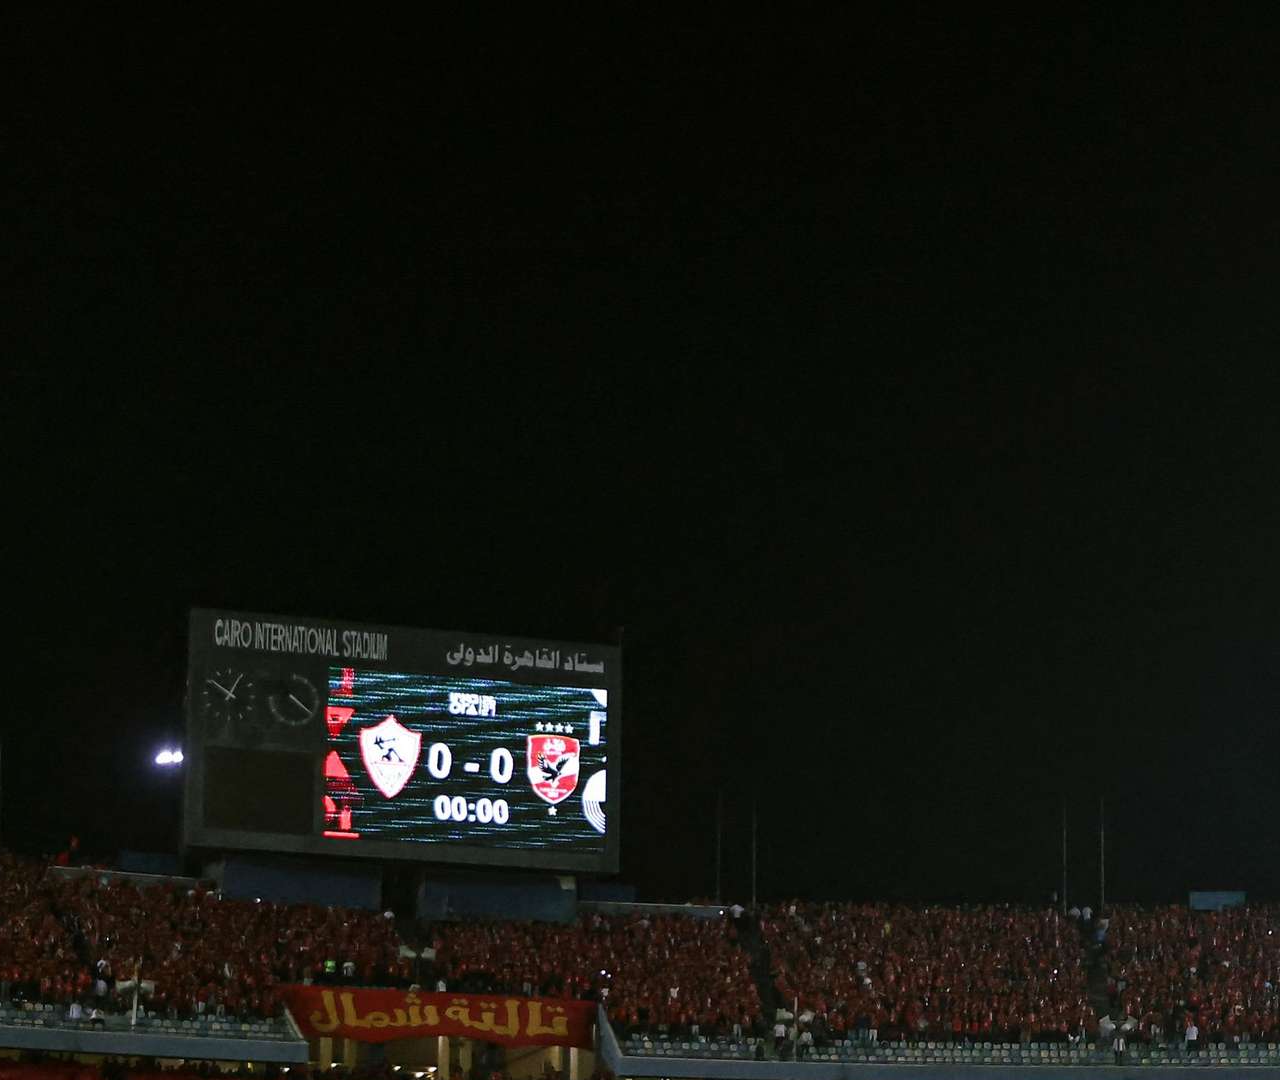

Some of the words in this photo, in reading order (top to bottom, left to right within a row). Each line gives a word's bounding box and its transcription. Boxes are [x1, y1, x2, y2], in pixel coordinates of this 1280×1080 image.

[214, 619, 252, 648] CAIRO
[255, 621, 340, 656] INTERNATIONAL
[342, 630, 388, 660] STADIUM
[503, 645, 560, 671] القاهرة
[564, 652, 604, 673] ستاد
[428, 742, 452, 779] 0
[490, 748, 514, 784] 0
[434, 794, 509, 825] 00:00
